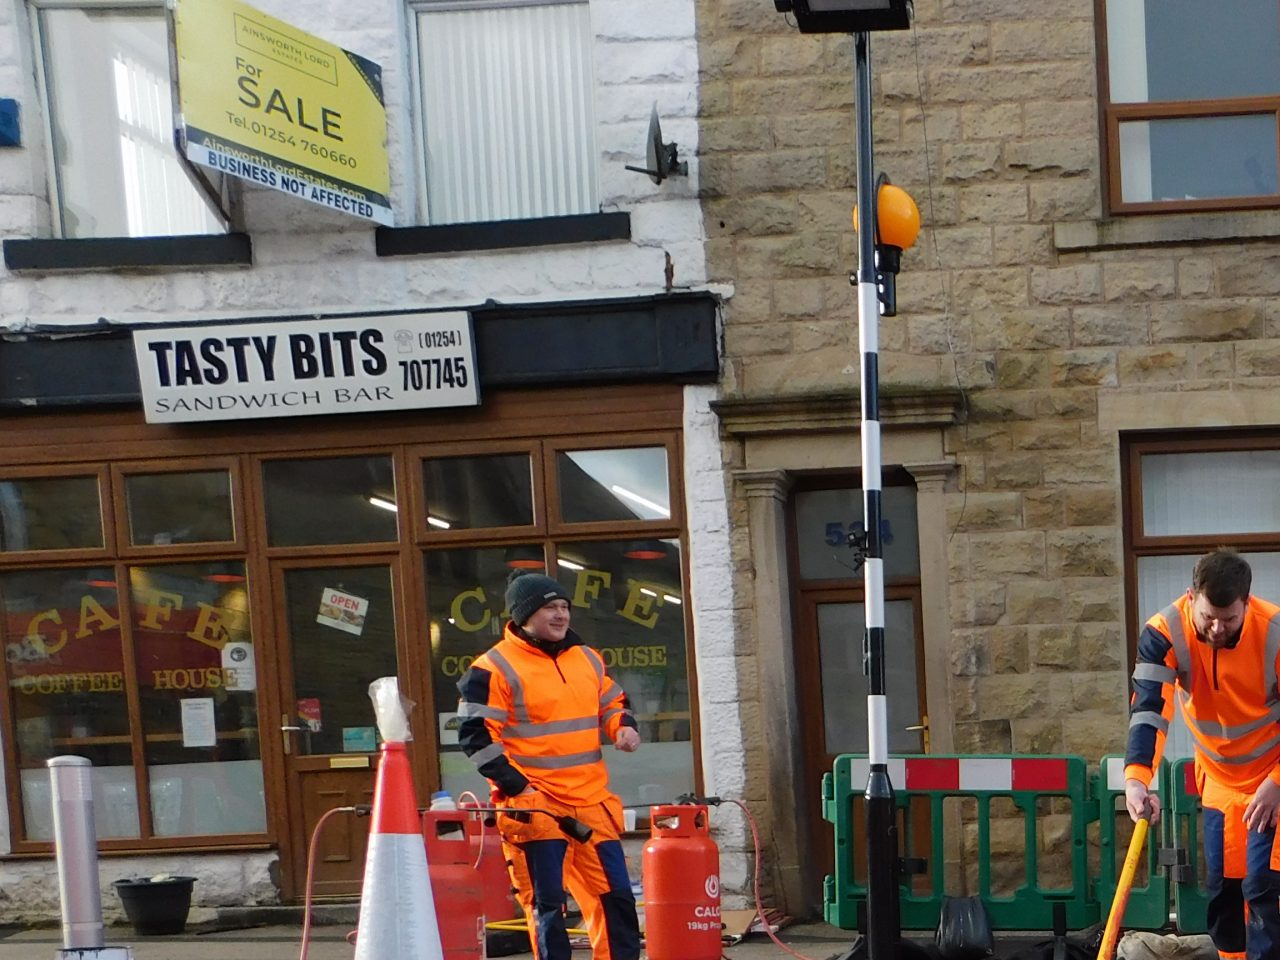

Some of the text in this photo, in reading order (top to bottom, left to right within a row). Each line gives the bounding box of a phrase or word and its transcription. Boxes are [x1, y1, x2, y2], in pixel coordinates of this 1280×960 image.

[242, 25, 329, 69] AINSWORTH LORD
[235, 57, 263, 78] For
[237, 76, 343, 142] SALE
[300, 139, 357, 169] 760660
[208, 152, 373, 218] BUSINESS NOT AFFECTED
[148, 335, 277, 387] TASTY
[289, 328, 388, 381] BITS
[398, 357, 468, 391] 707745
[155, 386, 394, 413] SANDWICH BAR
[331, 594, 359, 611] OPEN
[451, 570, 666, 632] CFE
[27, 589, 240, 654] CAFE
[597, 645, 667, 668] OUSE
[20, 671, 122, 694] COFFEE
[152, 667, 238, 690] HOUSE
[687, 921, 709, 931] 19kg
